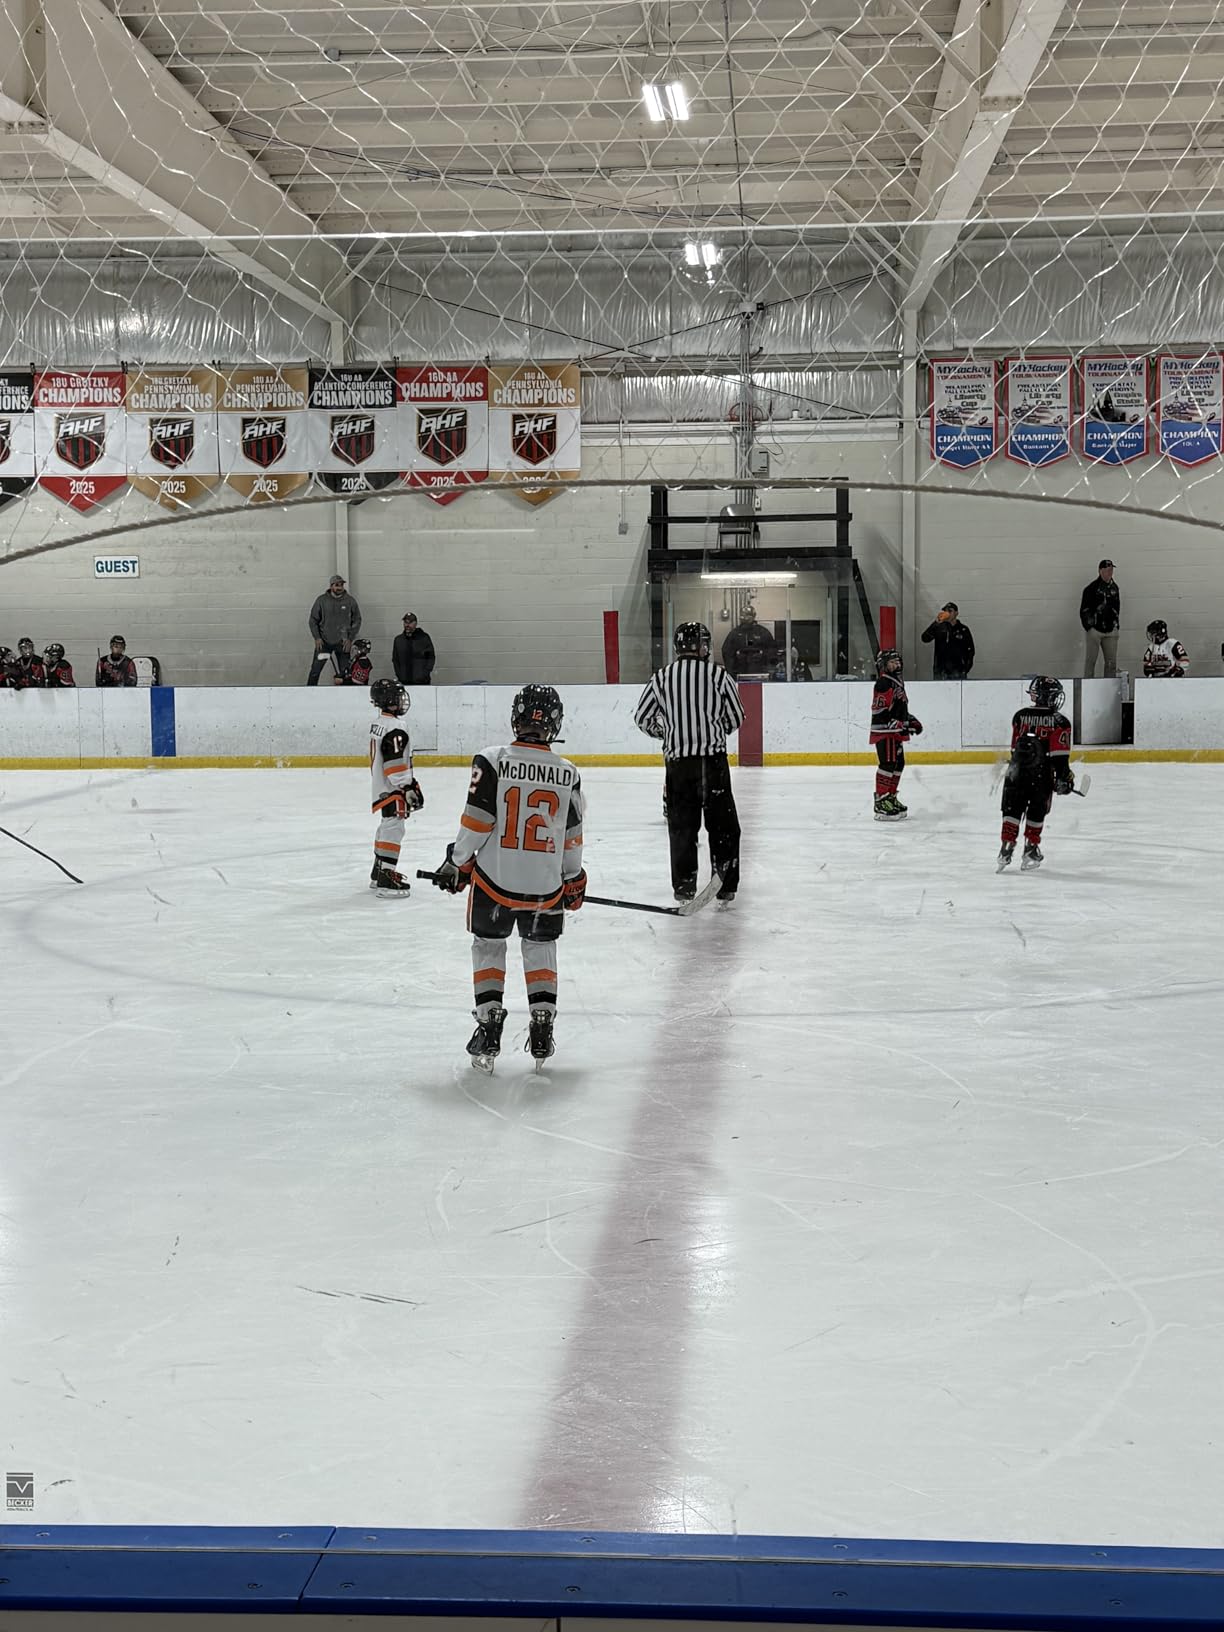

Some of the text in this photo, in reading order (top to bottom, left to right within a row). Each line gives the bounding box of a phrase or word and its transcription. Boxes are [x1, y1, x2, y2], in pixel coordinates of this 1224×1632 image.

[40, 388, 121, 403] CHAMPIONS
[313, 390, 393, 406] CHAMPIONS
[401, 382, 484, 398] CHAMPIONS
[494, 388, 576, 404] CHAMPIONS
[131, 393, 213, 409] CHAMPIONS
[223, 391, 304, 408] CHAMPIONS
[59, 416, 103, 438] AHF
[152, 421, 192, 439] AHF
[244, 420, 284, 439] AHF
[334, 419, 371, 436] AHF
[420, 412, 465, 433] AHF
[514, 417, 554, 436] AHF
[937, 434, 991, 443] CHAMPION
[1011, 433, 1065, 442] CHAMPION
[1087, 432, 1142, 440] CHAMPION
[1163, 430, 1219, 439] CHAMPION
[69, 481, 95, 494] 2025
[161, 481, 186, 493] 2025
[341, 478, 366, 490] 2025
[96, 560, 138, 573] GUEST
[531, 708, 543, 721] 12
[498, 761, 572, 787] McDONALD
[500, 786, 560, 854] 12
[7, 1499, 33, 1507] BECKER
